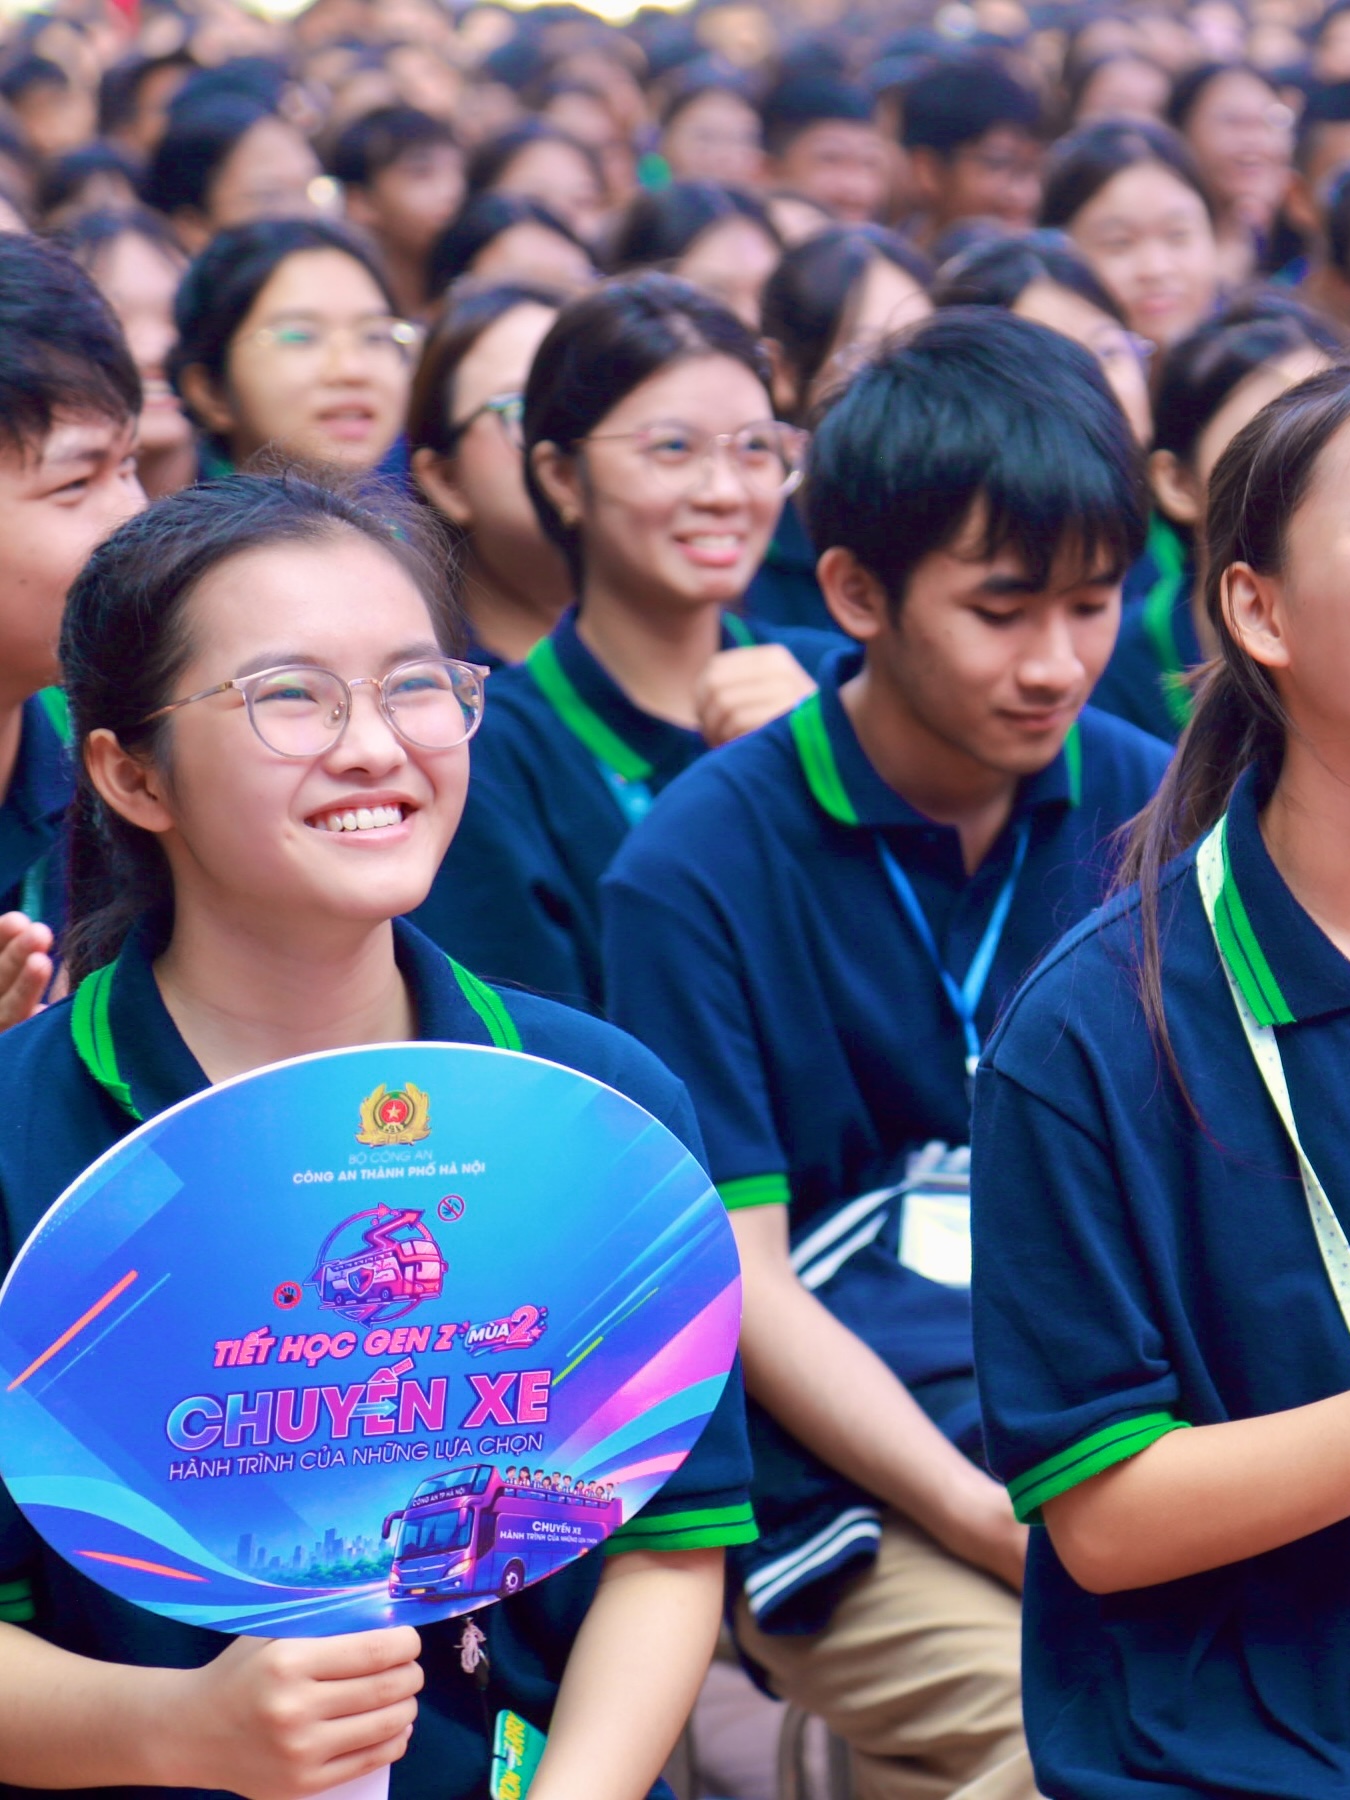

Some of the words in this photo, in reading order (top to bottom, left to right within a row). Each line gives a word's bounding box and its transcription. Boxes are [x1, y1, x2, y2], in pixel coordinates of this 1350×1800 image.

[293, 1169, 334, 1184] CÔNG
[337, 1169, 356, 1181] AN
[360, 1165, 404, 1180] THÀNH
[408, 1161, 437, 1176] PHỐ
[439, 1162, 458, 1175] HÀ
[461, 1160, 486, 1175] NỘI
[369, 1150, 411, 1164] CÔNG
[414, 1150, 433, 1161] AN
[467, 1322, 510, 1345] MÙA
[506, 1304, 541, 1345] 2
[213, 1325, 276, 1368] TIẾT
[277, 1330, 357, 1367] HỌC
[362, 1325, 432, 1357] GEN
[433, 1323, 459, 1351] Z
[165, 1357, 446, 1451] CHUYẾN
[464, 1370, 552, 1429] XE
[169, 1460, 230, 1482] HÀNH
[236, 1453, 294, 1475] TRÌNH
[300, 1445, 345, 1470] CỦA
[352, 1440, 429, 1466] NHỮNG
[434, 1437, 472, 1460] LỰA
[478, 1433, 544, 1458] CHỌN
[500, 1529, 525, 1540] HÀNH
[532, 1520, 571, 1534] CHUYẾN
